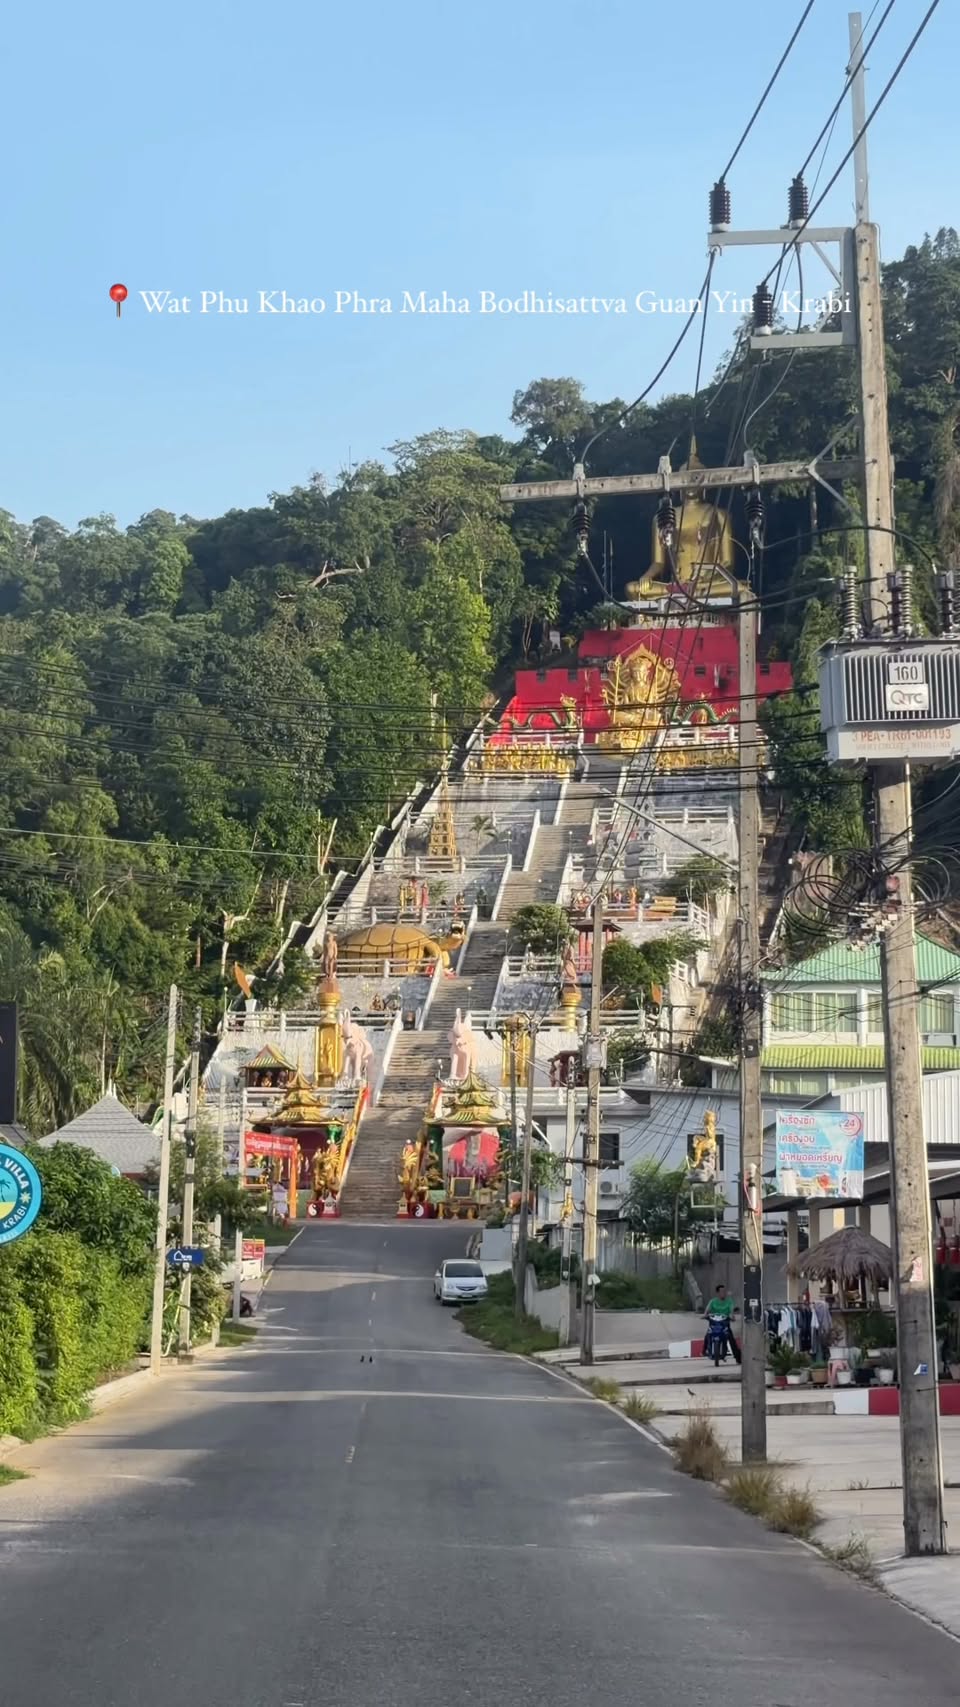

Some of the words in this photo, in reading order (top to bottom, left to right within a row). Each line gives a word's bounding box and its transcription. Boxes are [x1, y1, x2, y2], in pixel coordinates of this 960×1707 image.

[894, 666, 918, 681] 160
[890, 690, 924, 705] QTC
[4, 1158, 29, 1189] VILLA
[3, 1206, 27, 1229] KRABI
